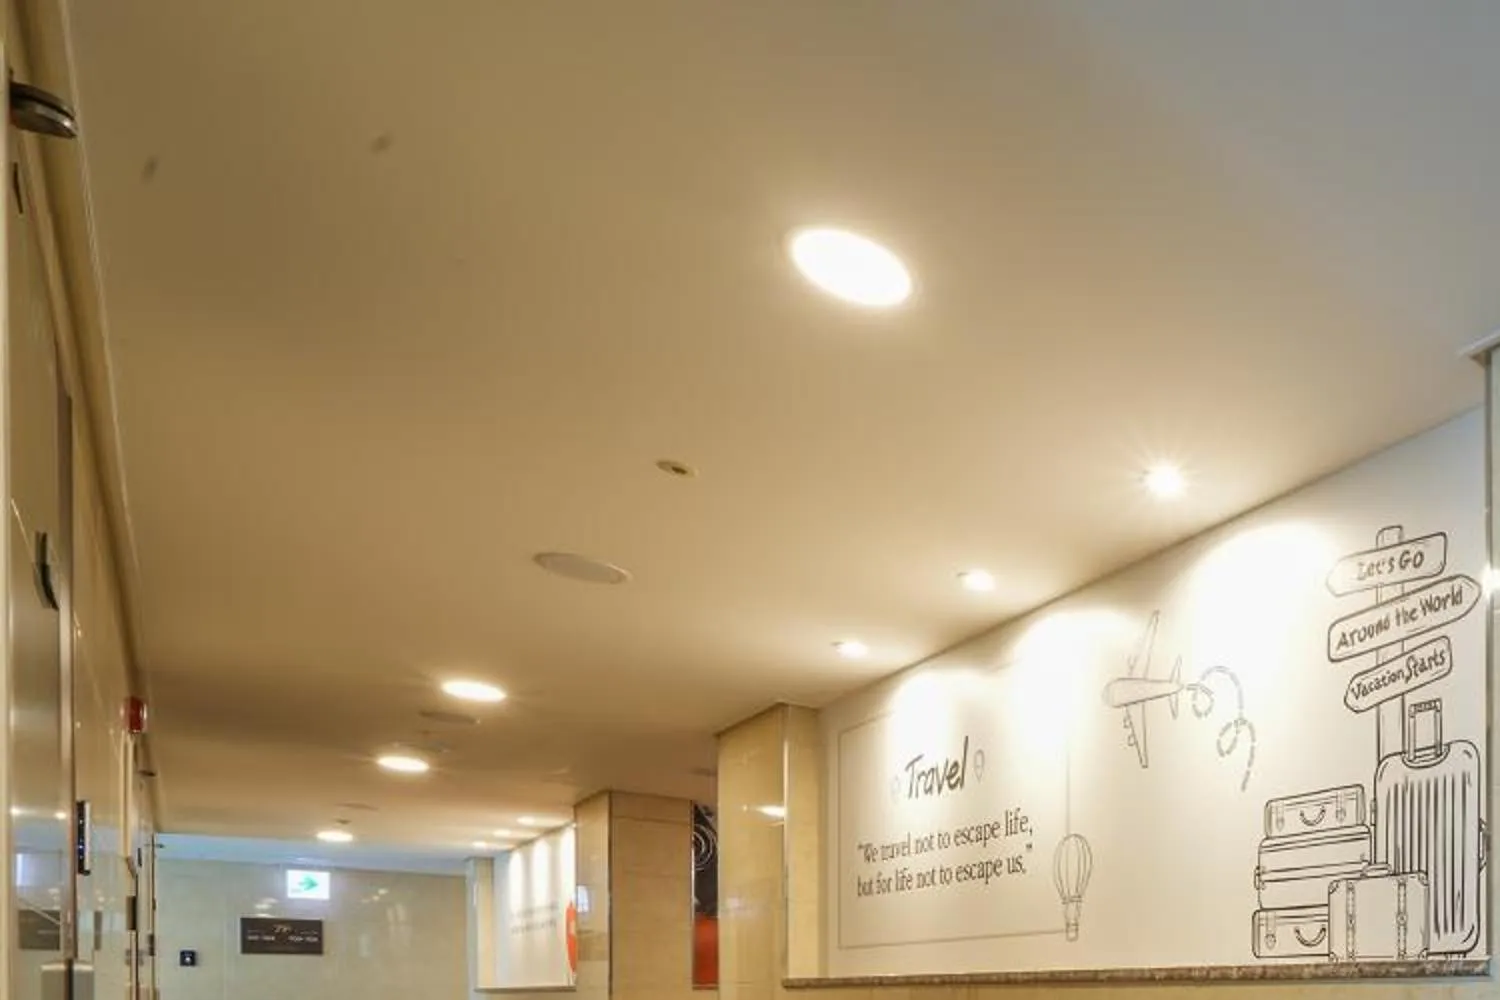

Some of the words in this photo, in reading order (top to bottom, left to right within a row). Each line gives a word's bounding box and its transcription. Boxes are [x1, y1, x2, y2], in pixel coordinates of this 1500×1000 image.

[1357, 556, 1395, 581] Let's
[1336, 612, 1390, 652] Around
[1395, 605, 1419, 627] the
[1419, 585, 1463, 617] World
[1350, 669, 1405, 700] Vacation
[1405, 648, 1446, 684] Starts
[904, 735, 969, 800] Travel
[881, 832, 911, 861] travel
[914, 834, 934, 855] not
[937, 831, 951, 850] to
[953, 820, 1001, 848] escape
[1004, 807, 1033, 836] life,
[857, 875, 874, 898] but
[875, 870, 892, 895] for
[895, 867, 913, 892] life
[916, 865, 936, 889] not
[939, 863, 953, 886] to
[955, 857, 1003, 885] escape
